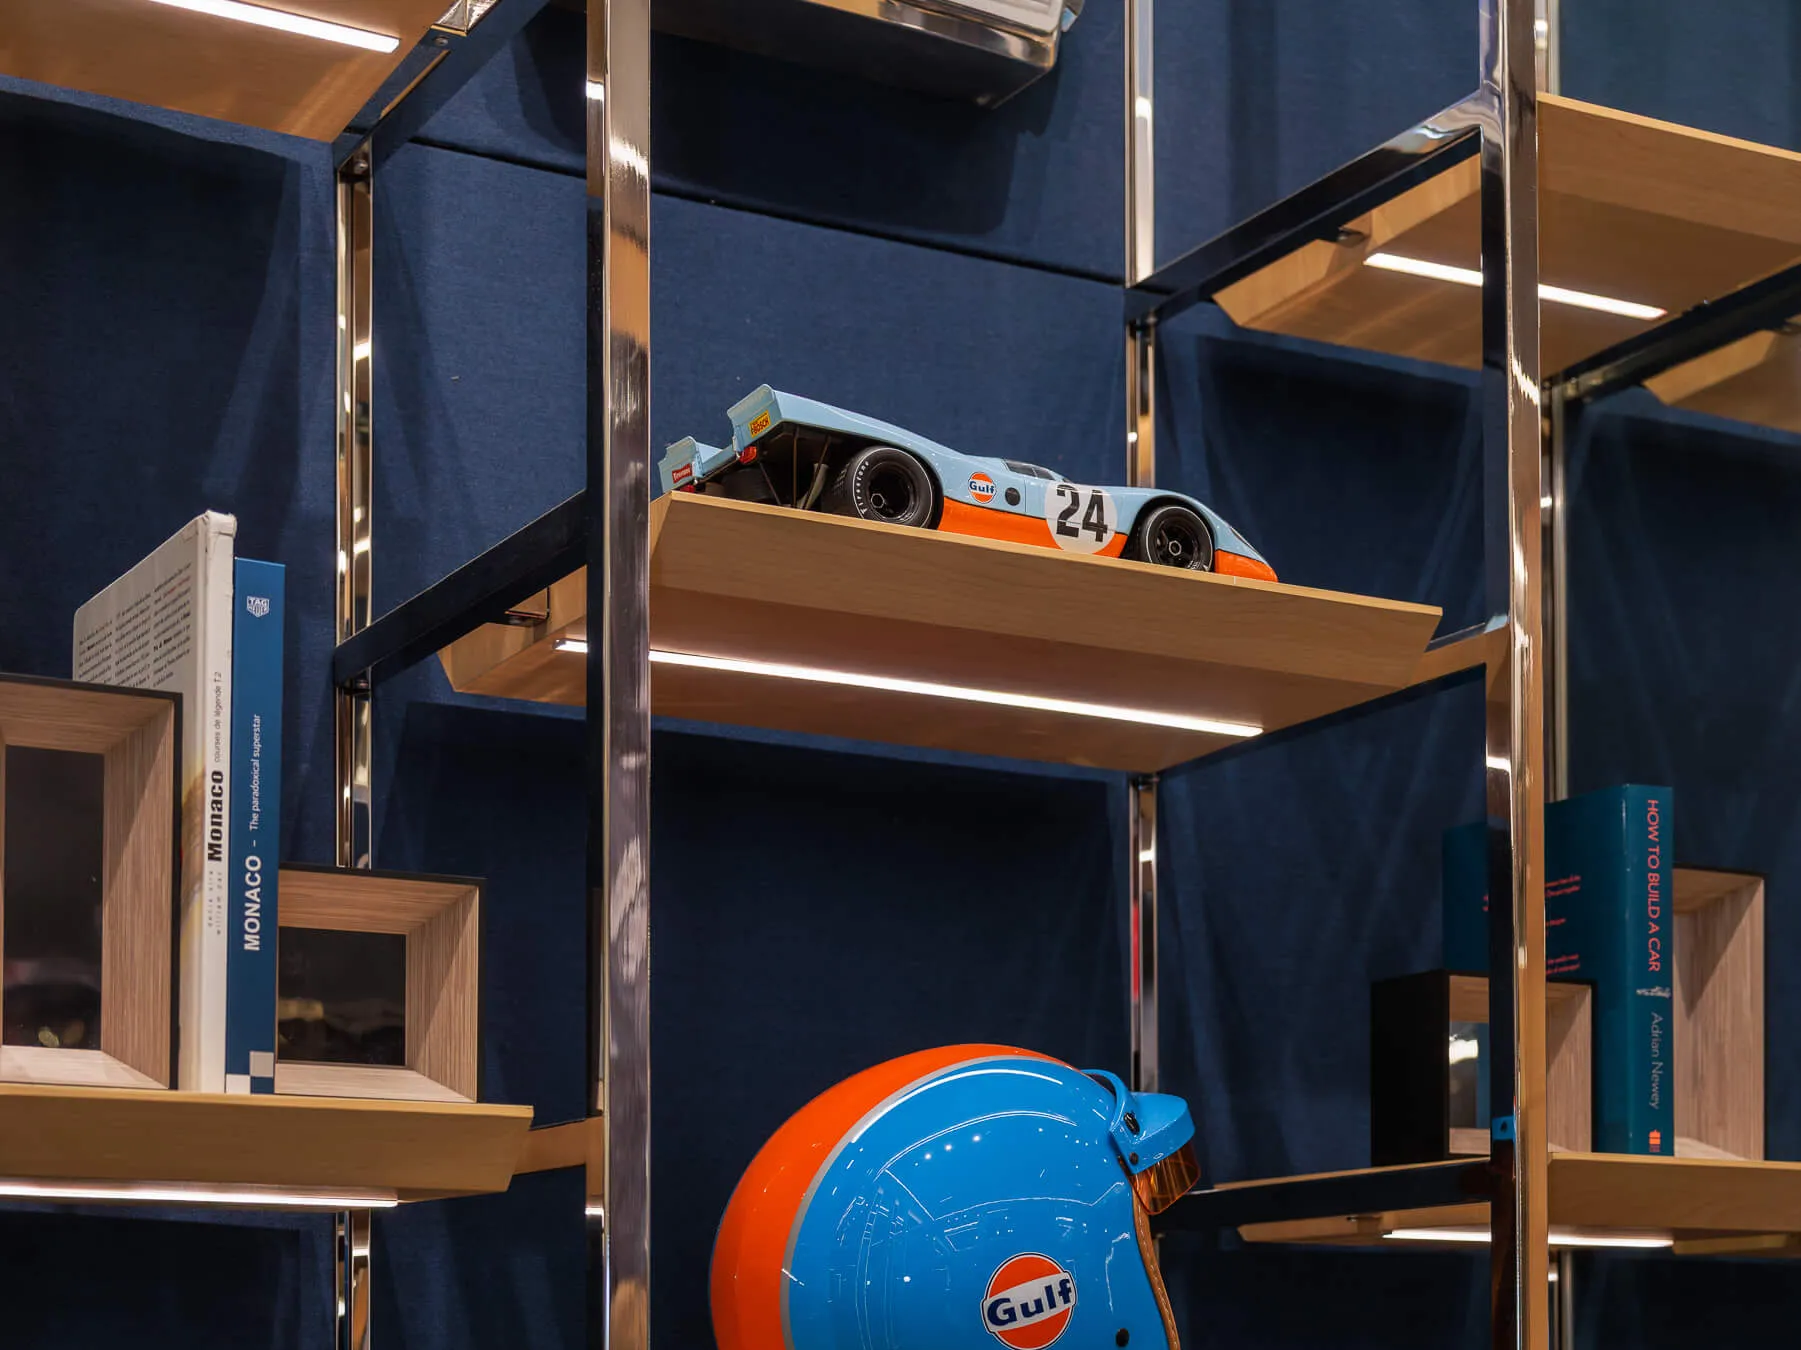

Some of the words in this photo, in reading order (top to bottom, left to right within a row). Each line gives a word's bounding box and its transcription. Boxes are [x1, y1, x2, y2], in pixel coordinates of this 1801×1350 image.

[969, 480, 995, 495] Gulf
[1056, 484, 1108, 542] 24
[213, 720, 221, 730] de
[253, 714, 262, 758] superstar
[250, 759, 261, 811] paradoxical
[207, 770, 223, 862] Monaco
[249, 813, 260, 831] The
[1647, 799, 1659, 842] HOW
[1647, 845, 1660, 869] TO
[244, 855, 261, 951] MONACO
[1647, 872, 1660, 919] BUILD
[1648, 921, 1660, 934] A
[1648, 937, 1661, 972] CAR
[1651, 1011, 1664, 1058] Adrian
[1649, 1061, 1664, 1110] Newey
[986, 1278, 1072, 1326] Gulf
